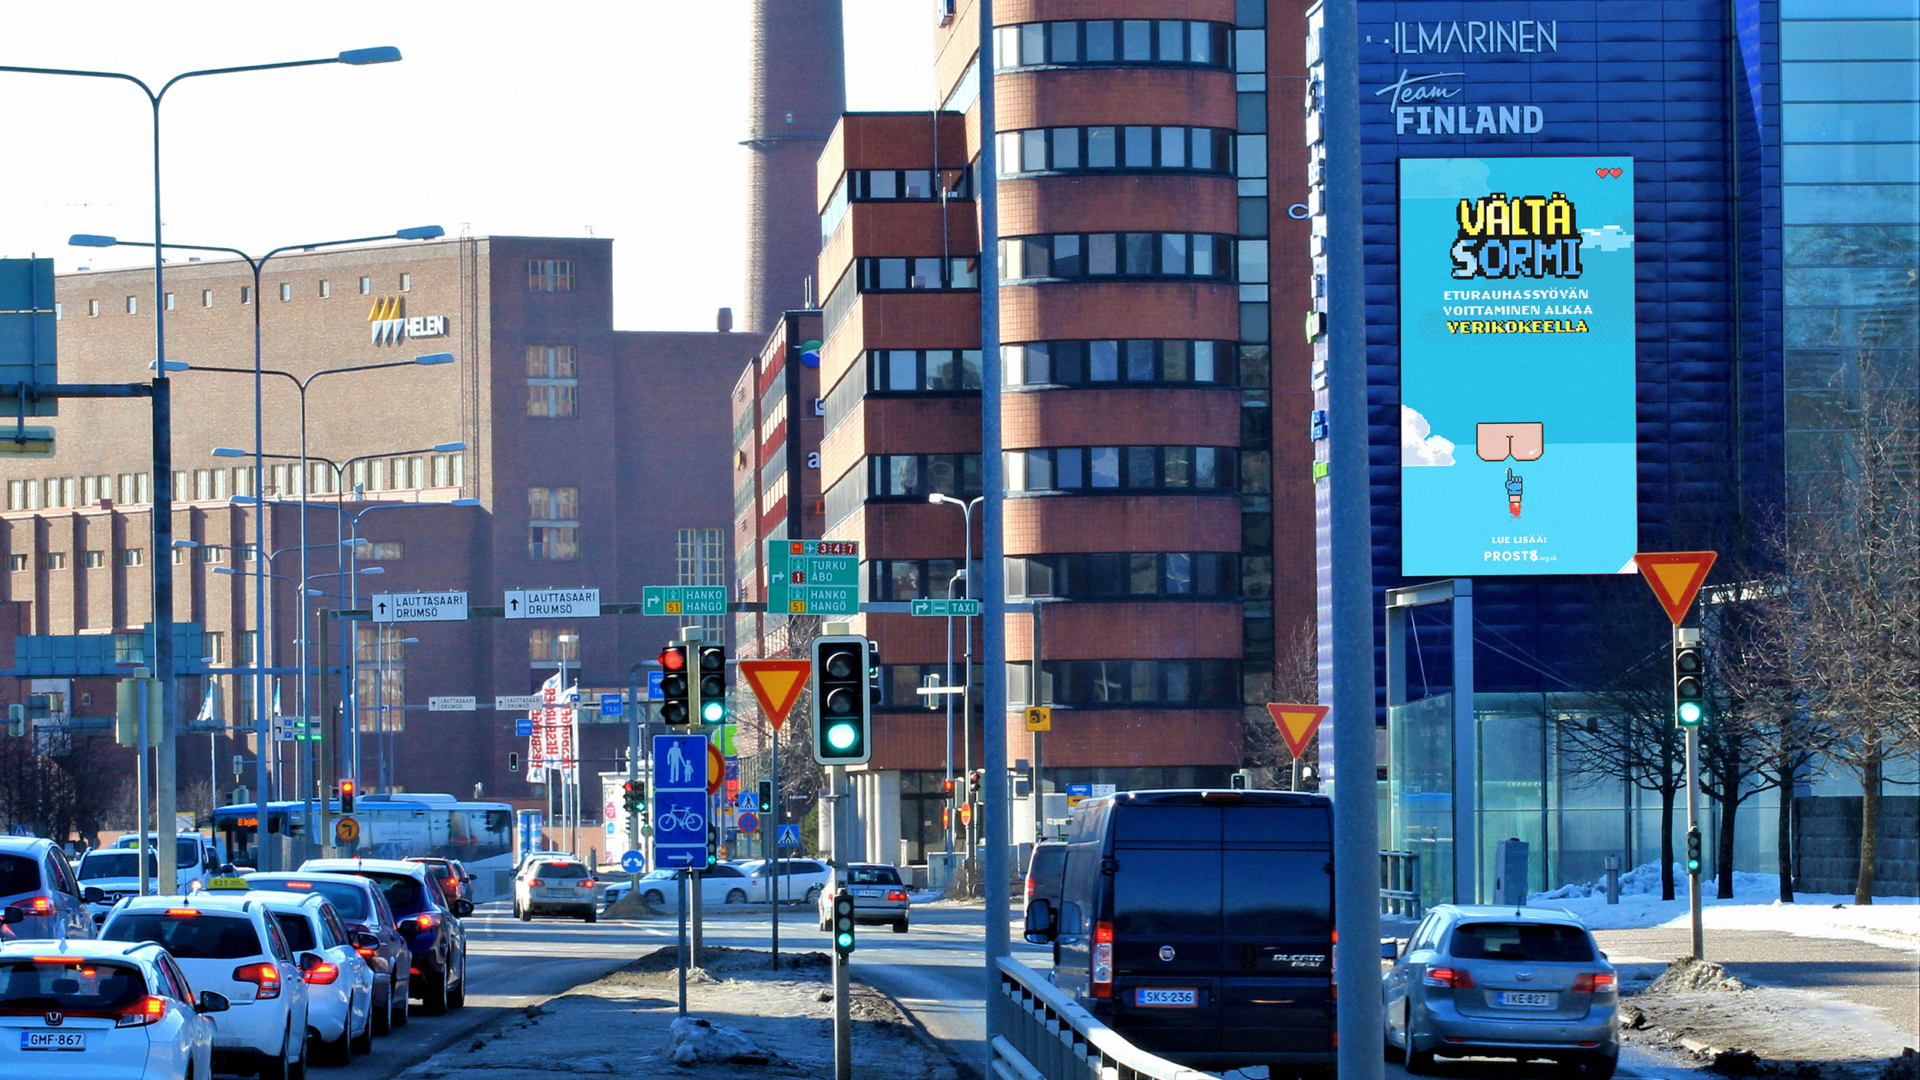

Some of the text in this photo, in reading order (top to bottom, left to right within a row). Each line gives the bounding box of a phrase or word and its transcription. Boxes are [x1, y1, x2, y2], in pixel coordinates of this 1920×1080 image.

[1394, 20, 1557, 54] ILMARINEN
[1396, 105, 1544, 134] FINLAND
[1459, 192, 1574, 236] VÄLTÄ
[1451, 239, 1582, 277] SORMI
[1443, 287, 1589, 300] ETURAUHASSYÖVÄN
[1443, 304, 1594, 316] VOITTAMINEN ALKAA
[404, 315, 444, 337] HELEN
[1446, 320, 1590, 334] VERIKOKEELLA
[1491, 534, 1547, 544] LUE LISÄÄ:
[811, 560, 847, 571] TURKU
[811, 571, 833, 582] ÅBO
[528, 592, 596, 603] LAUTTASAARI
[686, 591, 723, 600] HANKO
[810, 590, 847, 600] HANKO
[396, 595, 463, 607] LAUTTASAARI
[686, 600, 723, 611] HANGÖ
[810, 600, 847, 611] HANGÖ
[396, 607, 438, 618] DRUMSÖ
[528, 604, 573, 615] DRUMSÖ
[667, 603, 681, 613] 51
[792, 602, 805, 612] 51
[952, 603, 975, 613] TAXI
[1146, 991, 1192, 1003] SKS-236
[30, 1033, 83, 1046] GMF-867
